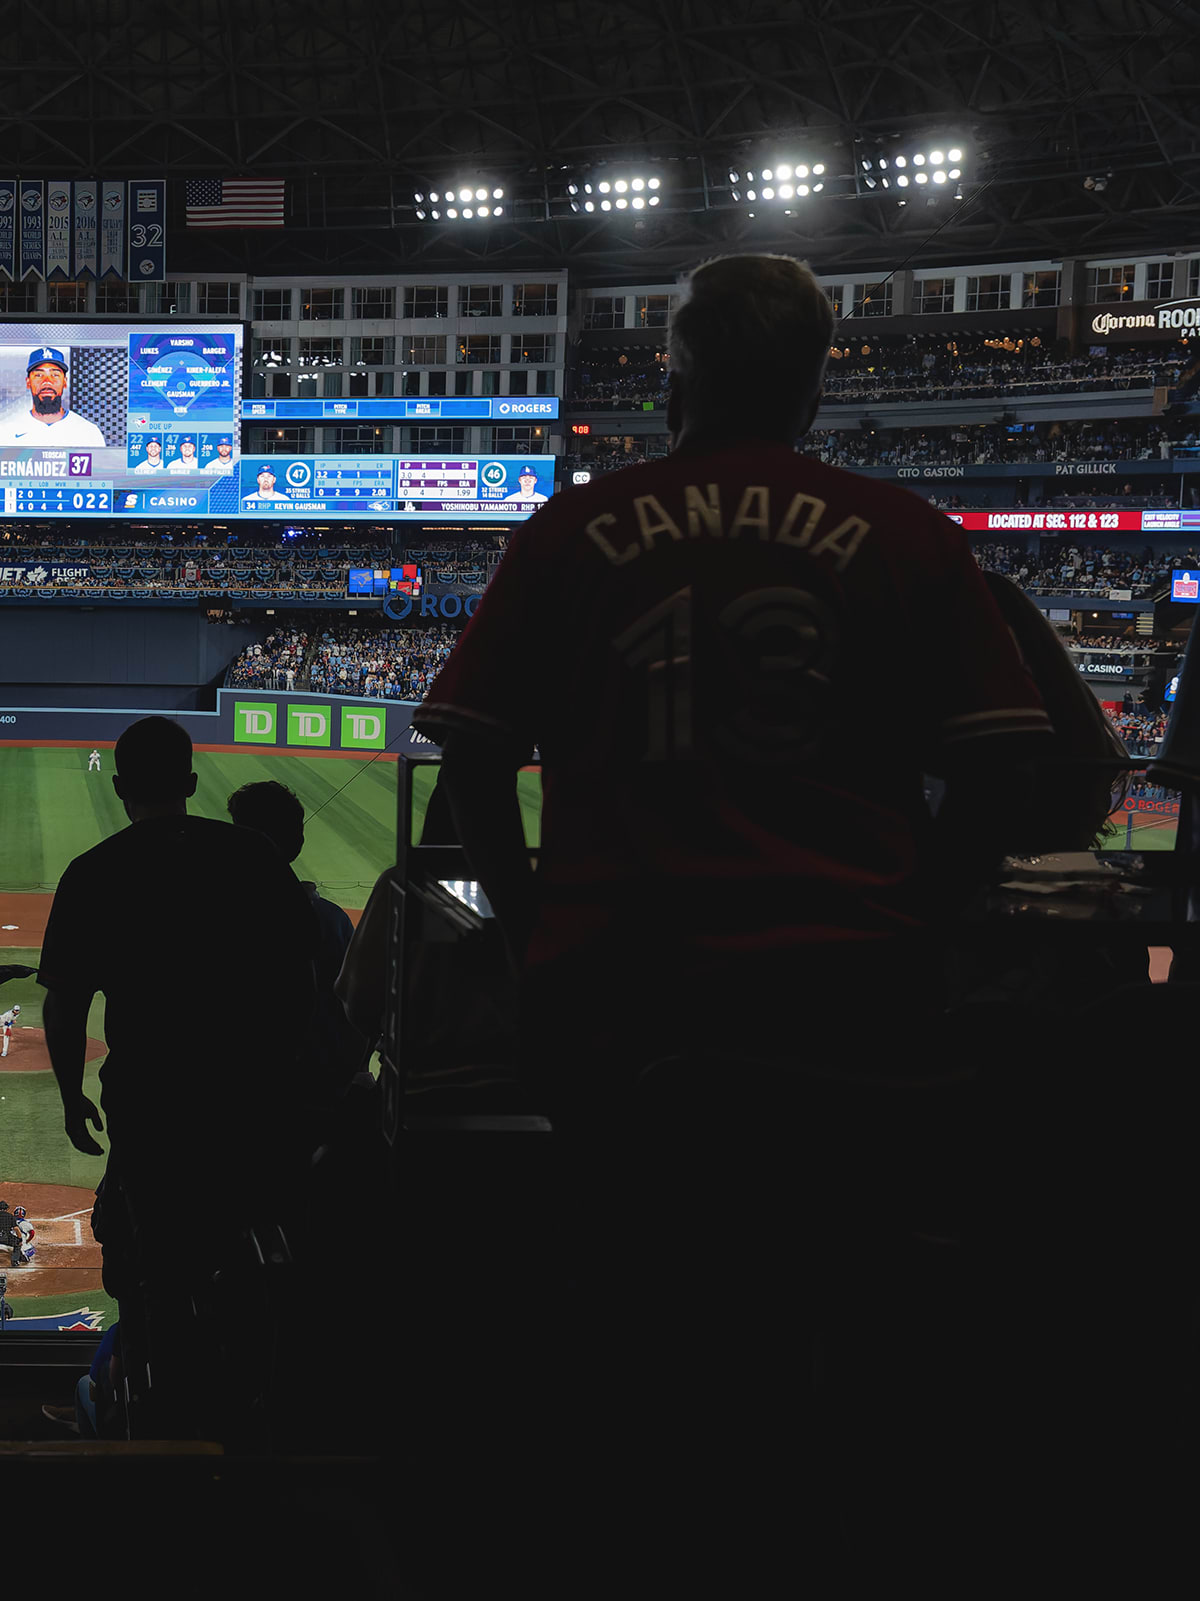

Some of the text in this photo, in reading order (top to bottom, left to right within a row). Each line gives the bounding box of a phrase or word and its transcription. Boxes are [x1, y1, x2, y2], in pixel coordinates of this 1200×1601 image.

[23, 216, 41, 229] 1993
[49, 216, 68, 229] 2015
[76, 217, 95, 229] 2016
[131, 224, 163, 248] 32
[1092, 313, 1156, 335] Corona
[1181, 328, 1200, 338] PA
[512, 404, 551, 413] ROGERS
[130, 435, 143, 443] 22
[166, 435, 179, 443] 47
[201, 435, 208, 443] 7
[71, 456, 89, 474] 37
[1056, 463, 1116, 475] PAT GILLICK
[293, 470, 305, 479] 47
[488, 469, 500, 479] 46
[897, 467, 964, 477] CITO GASTON
[150, 497, 197, 506] CASINO
[441, 503, 534, 511] YOSHINOBU YAMAMOTO RHP
[988, 514, 1118, 528] LOCATED AT SEC. 112 & 123
[585, 483, 872, 572] CANADA
[51, 568, 88, 577] FLIGHT
[1087, 664, 1123, 674] CASINO
[0, 715, 16, 724] 400
[239, 709, 272, 734] TD
[292, 712, 326, 737] TD
[346, 714, 381, 740] TD
